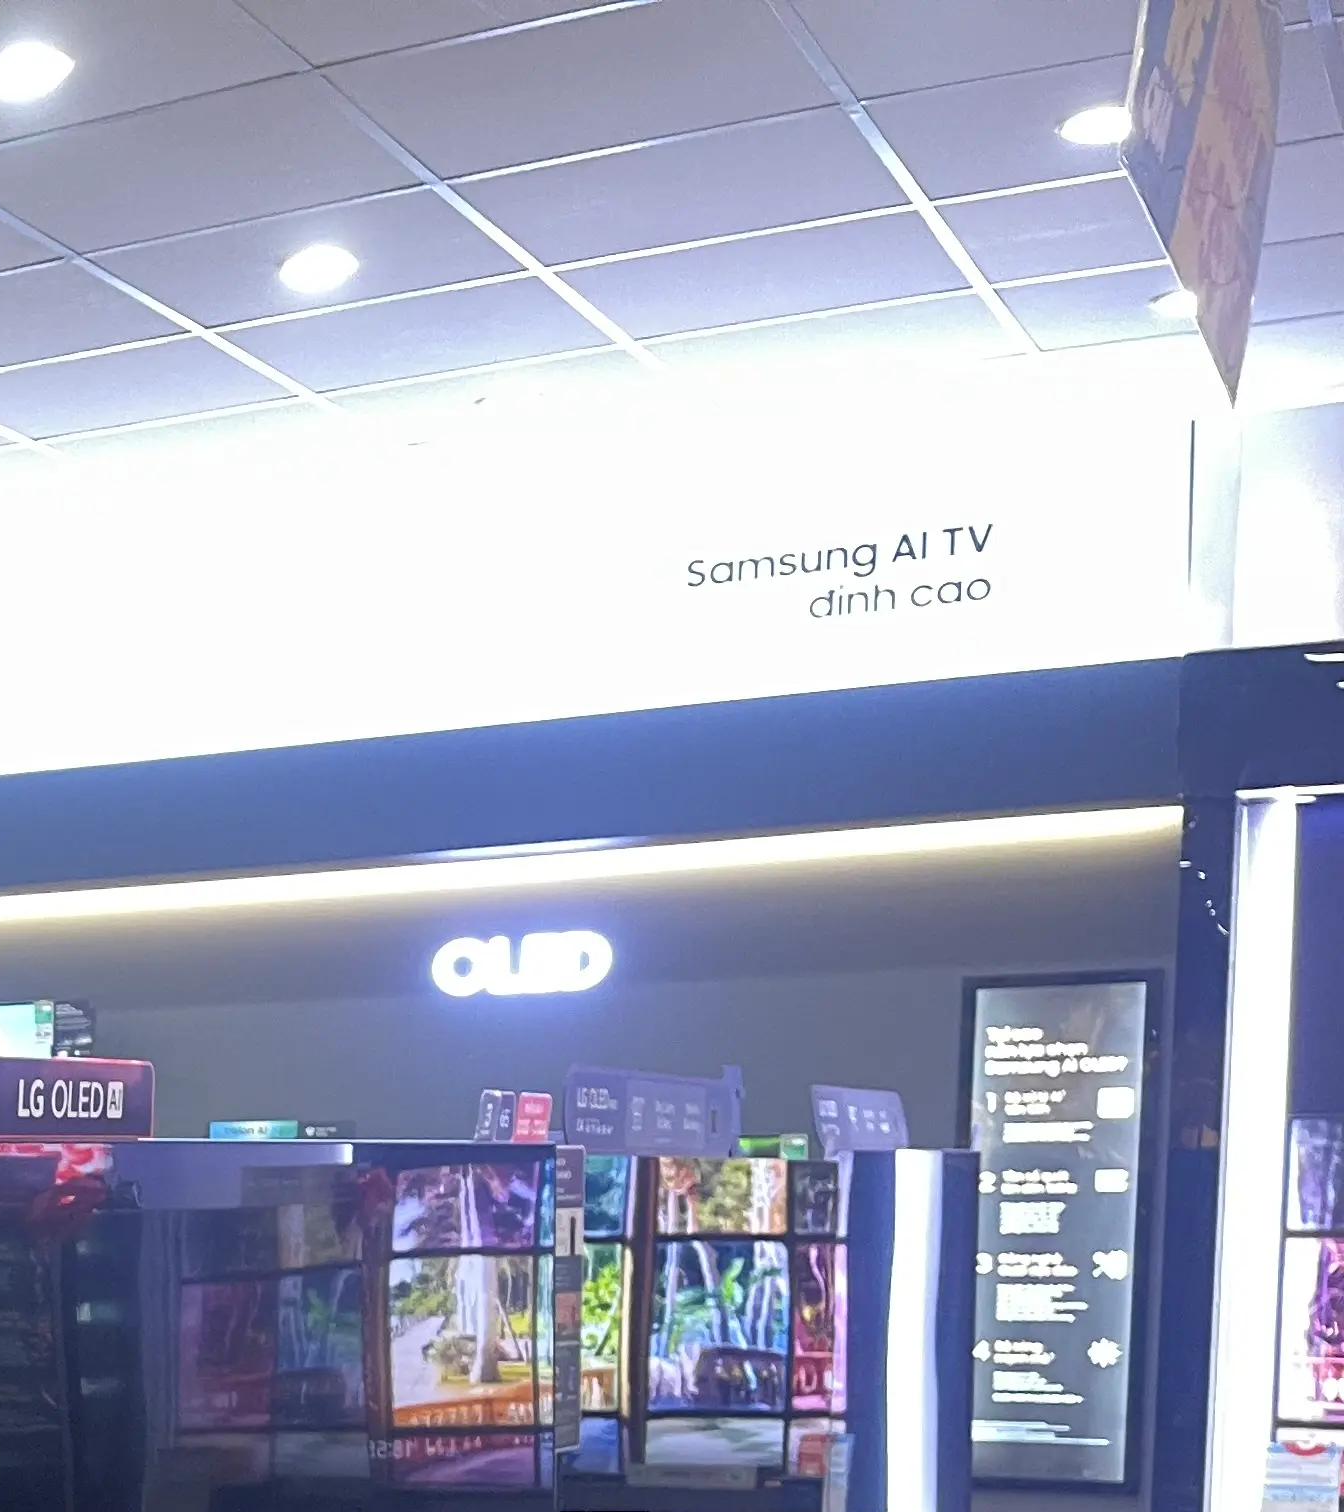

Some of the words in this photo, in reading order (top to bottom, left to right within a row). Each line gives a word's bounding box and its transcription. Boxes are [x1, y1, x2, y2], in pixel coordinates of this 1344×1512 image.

[687, 543, 877, 587] Samsung
[892, 531, 927, 563] AI
[942, 523, 993, 555] TV
[910, 578, 992, 608] cao
[431, 930, 613, 997] OLED
[17, 1079, 44, 1118] LG
[51, 1079, 104, 1119] OLED
